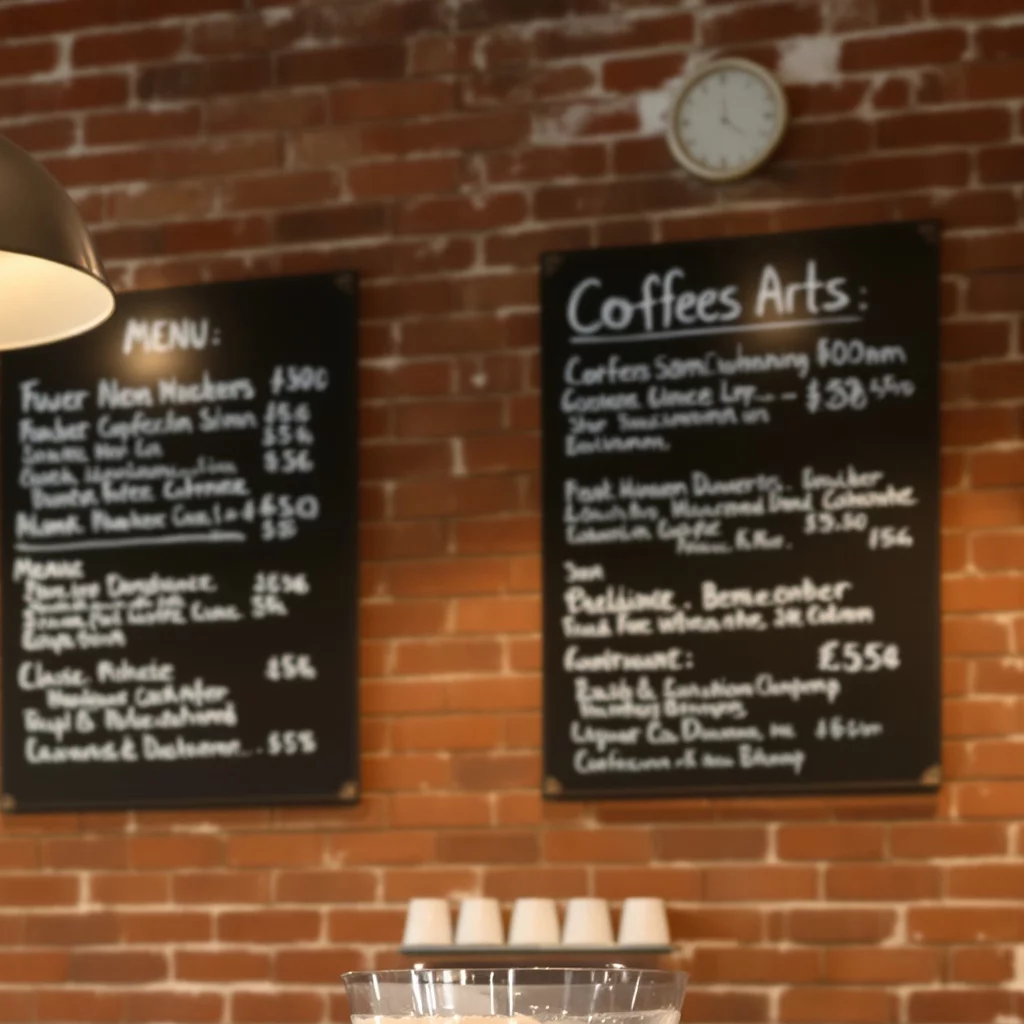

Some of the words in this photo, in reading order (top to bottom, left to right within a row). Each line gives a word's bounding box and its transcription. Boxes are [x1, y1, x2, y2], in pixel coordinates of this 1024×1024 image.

[566, 267, 742, 334] Coffees
[755, 259, 868, 316] Arts:
[123, 317, 222, 354] MENU:
